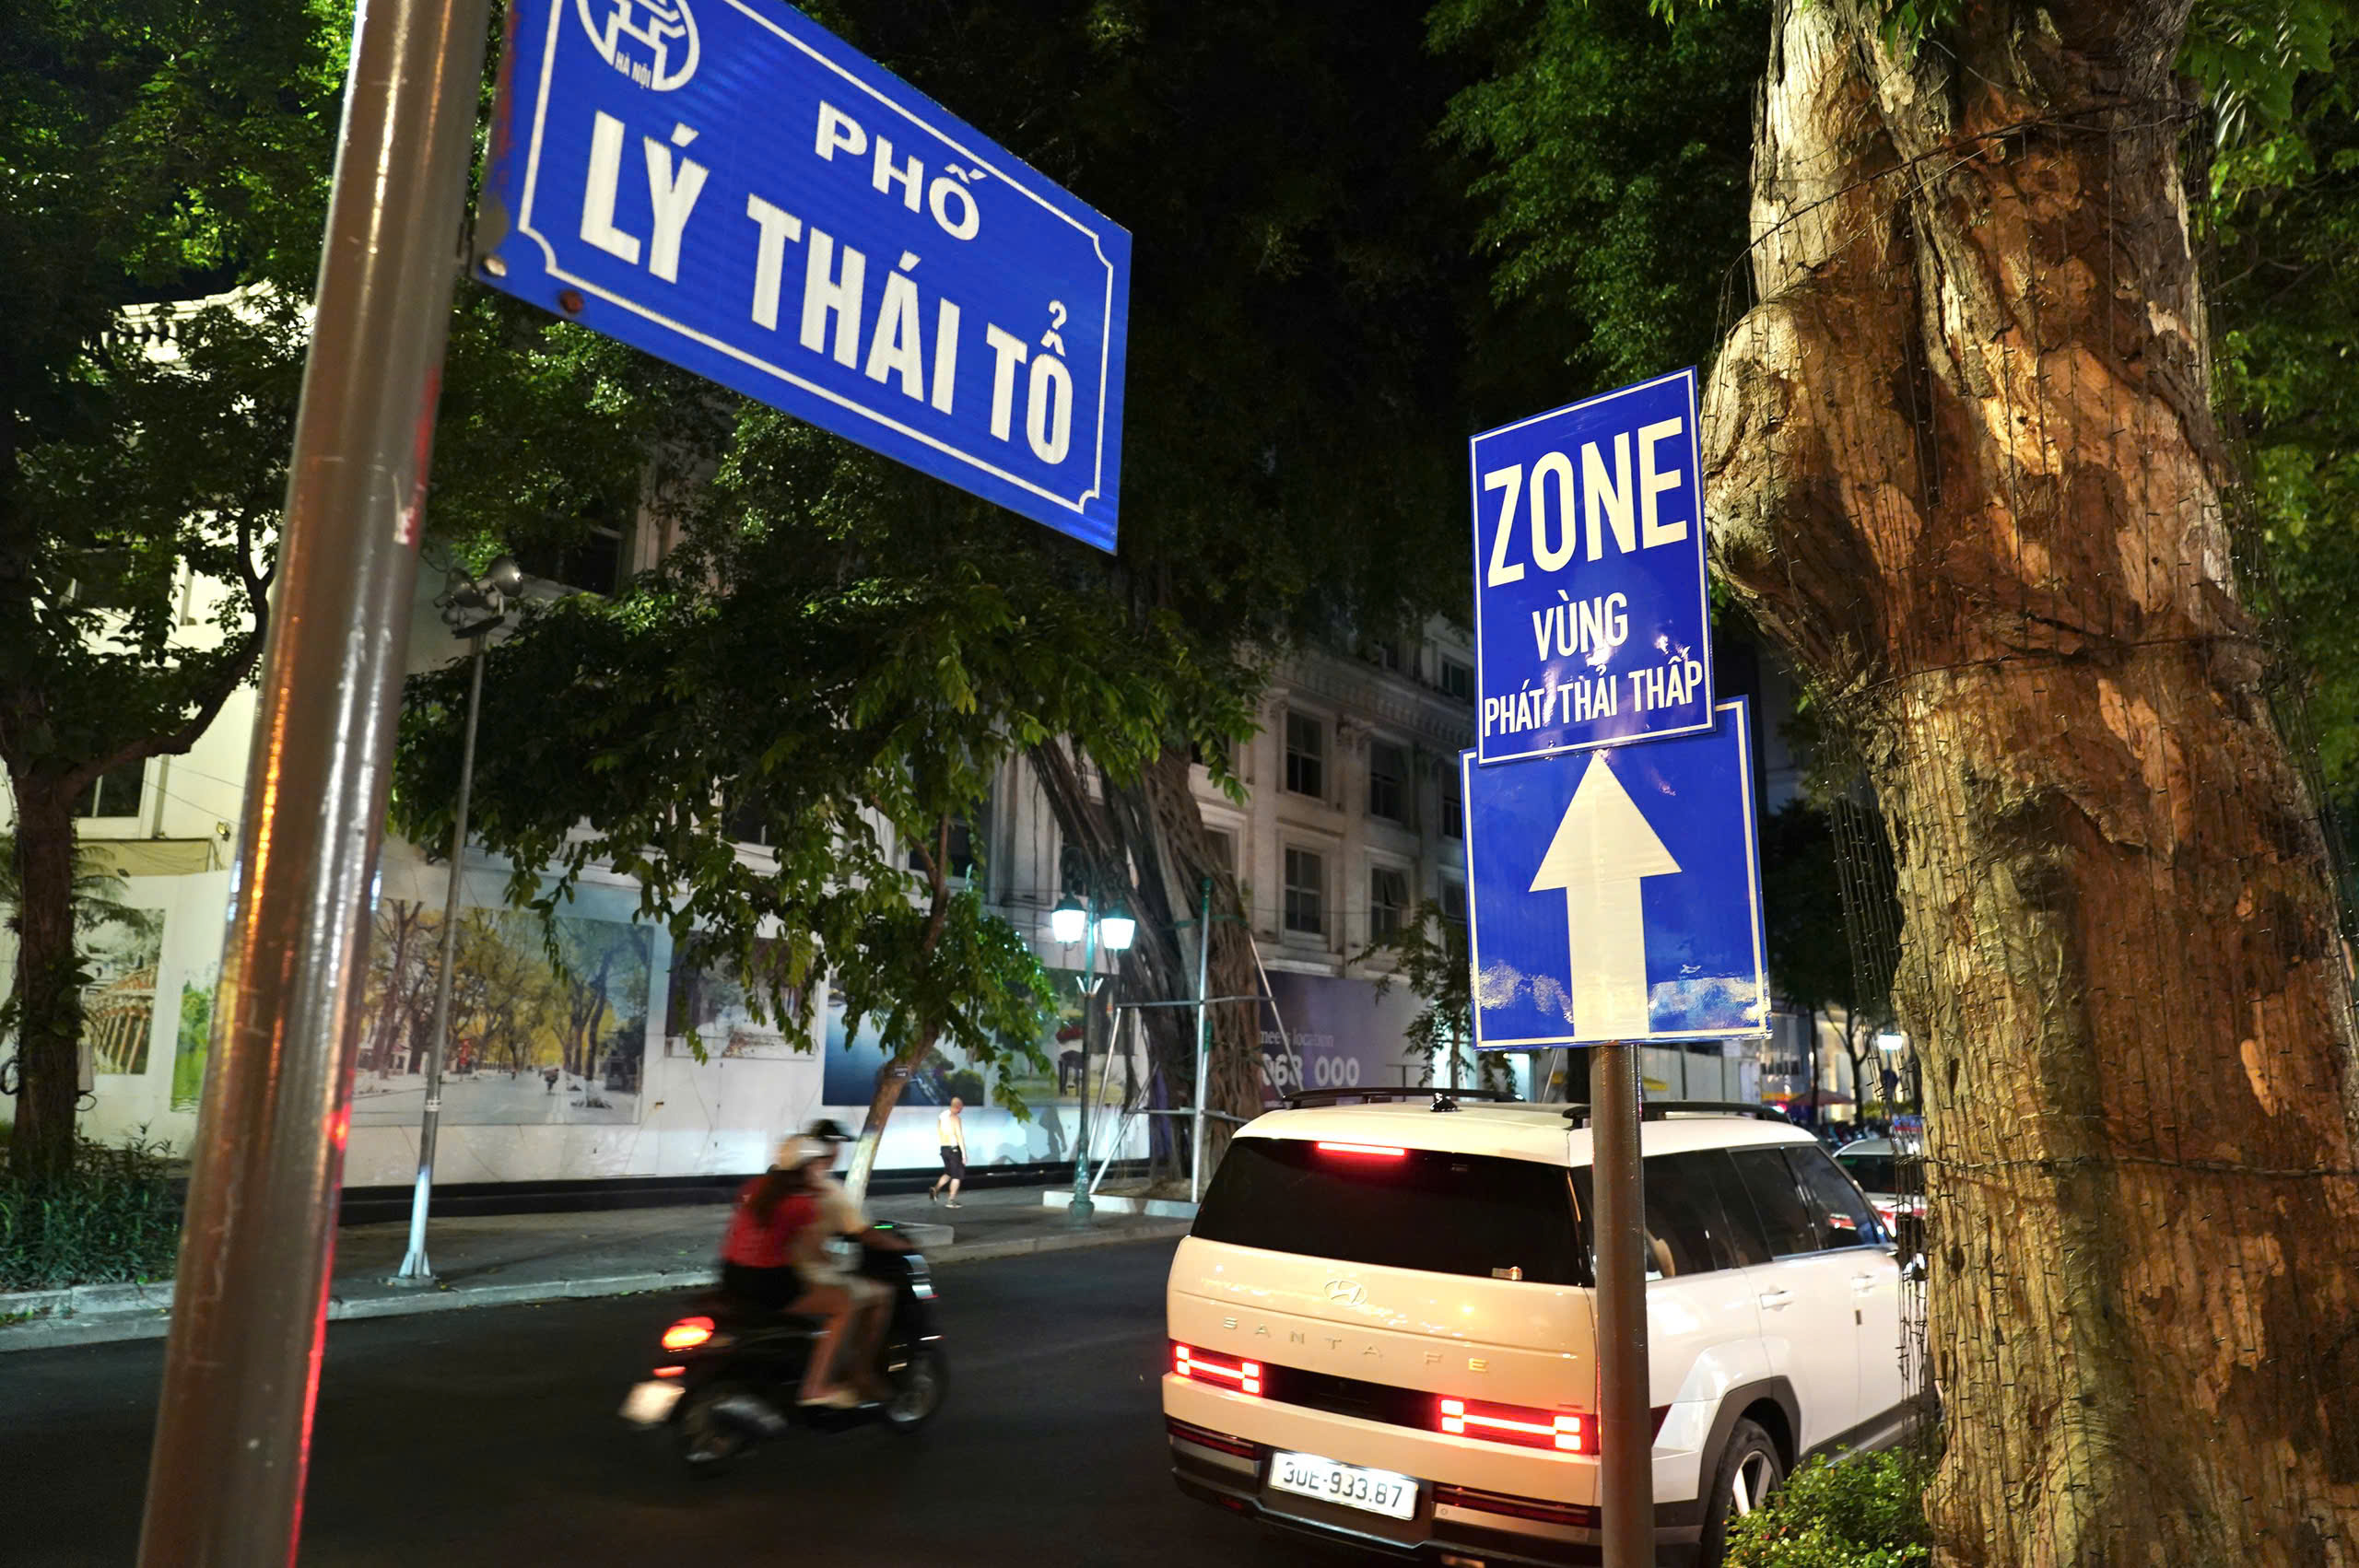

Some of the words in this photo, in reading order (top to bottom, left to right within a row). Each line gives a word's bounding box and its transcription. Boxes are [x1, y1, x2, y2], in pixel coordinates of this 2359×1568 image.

[815, 99, 987, 241] PHỐ
[580, 110, 710, 285] LÝ
[746, 193, 961, 415] THÁI
[985, 299, 1074, 465] TỔ
[1484, 415, 1688, 588] ZONE
[1532, 589, 1629, 662] VÙNG
[1484, 678, 1546, 738] PHÁT
[1556, 663, 1618, 725] THẢI
[1627, 646, 1704, 713] THẤP
[1314, 1055, 1360, 1087] 000
[1223, 1316, 1384, 1358] SANTA
[1425, 1350, 1489, 1374] FE
